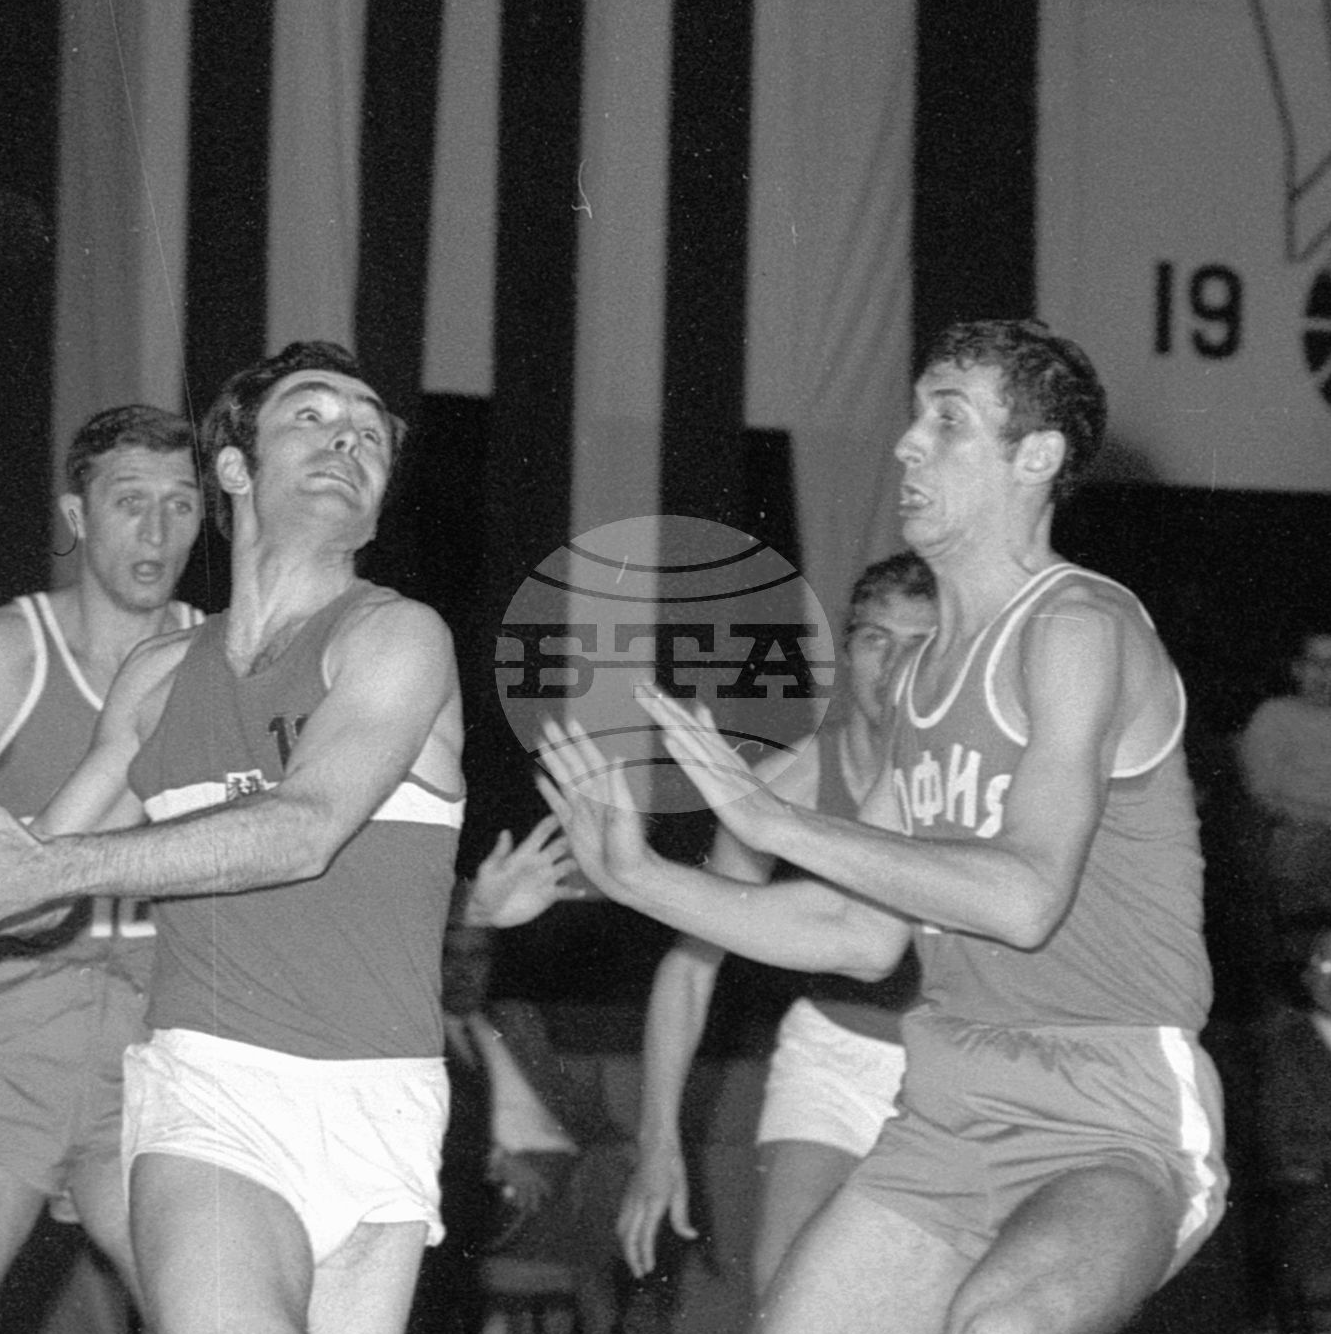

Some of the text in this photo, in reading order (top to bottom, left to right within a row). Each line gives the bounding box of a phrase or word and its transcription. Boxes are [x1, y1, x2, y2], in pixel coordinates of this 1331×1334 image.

[1153, 261, 1244, 360] 19
[268, 715, 309, 772] 1
[894, 743, 1012, 838] ОФИ
